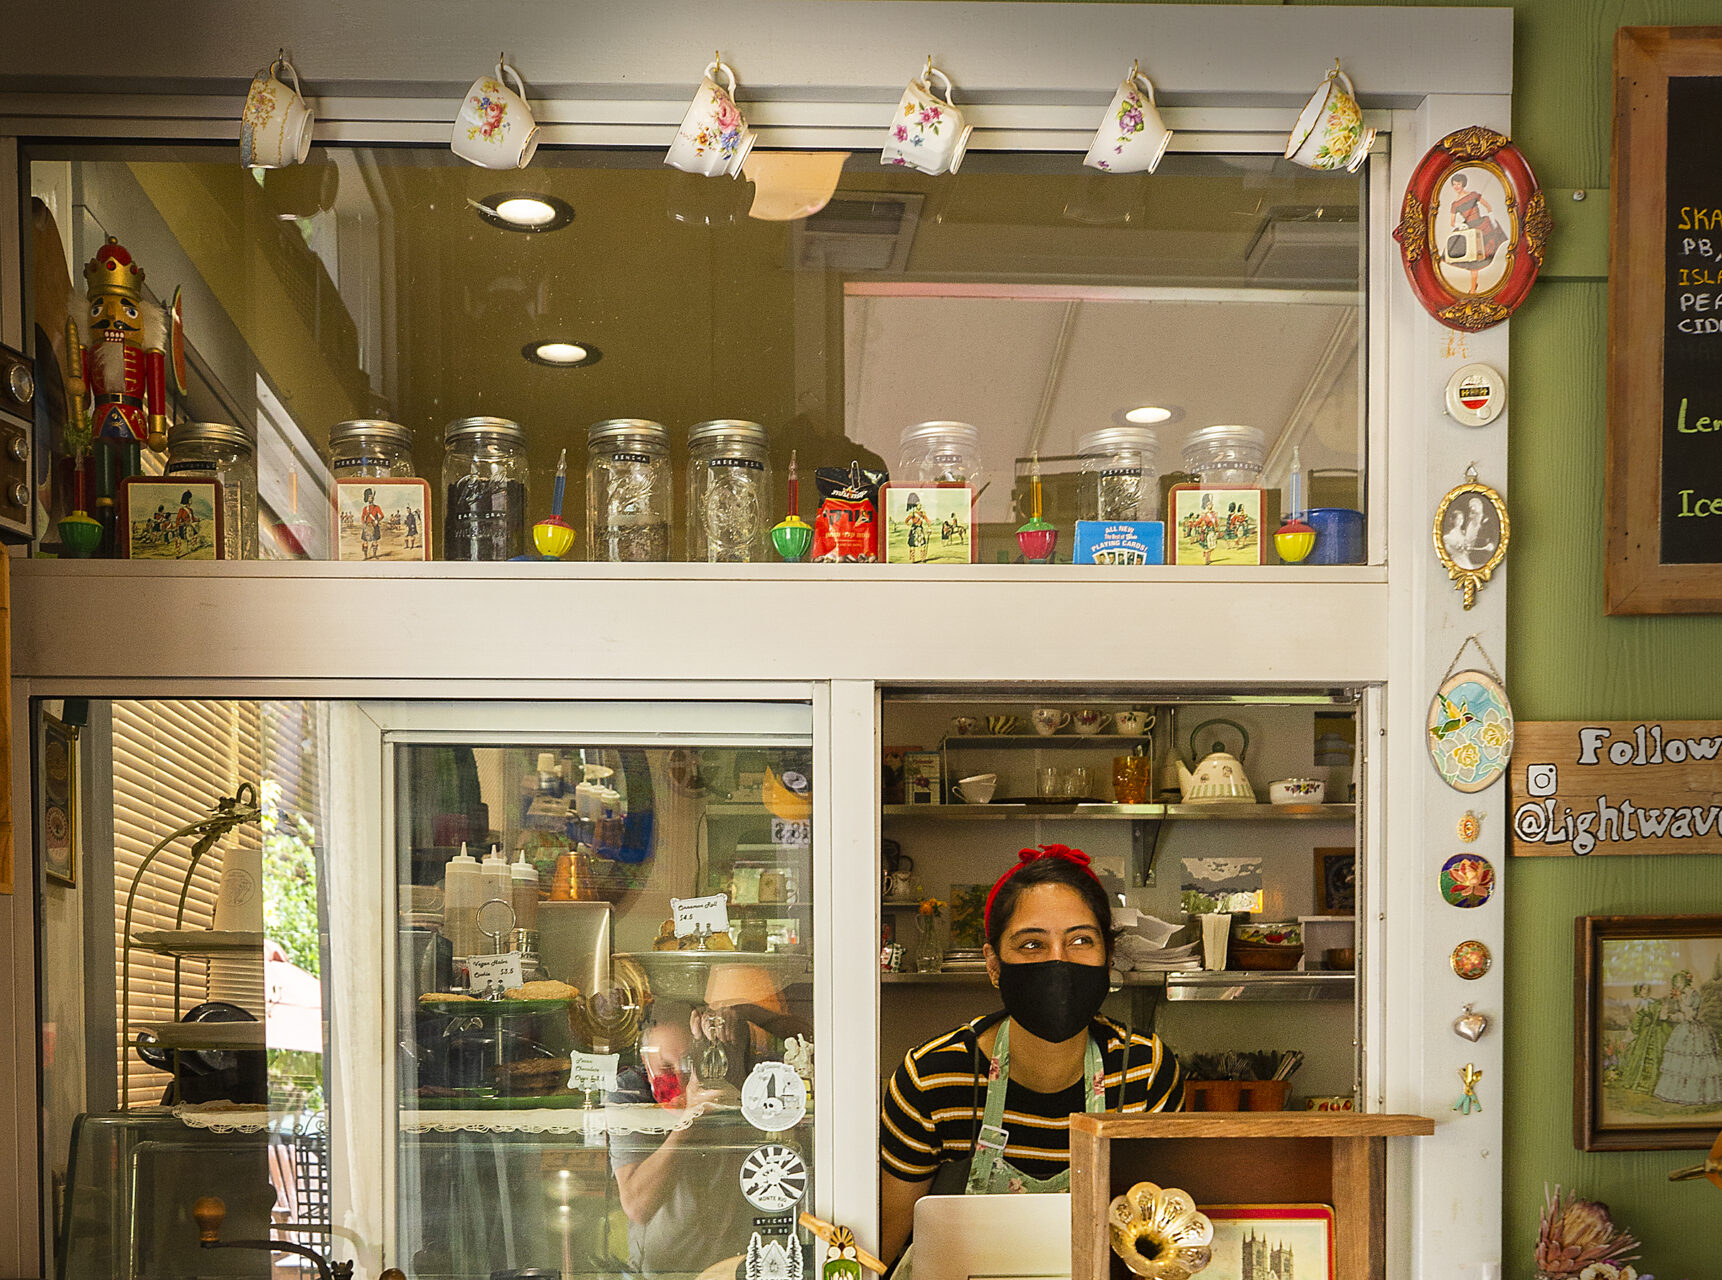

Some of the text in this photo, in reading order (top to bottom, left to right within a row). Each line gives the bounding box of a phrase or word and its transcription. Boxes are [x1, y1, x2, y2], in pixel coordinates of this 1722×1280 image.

[1682, 238, 1722, 262] PB,
[1677, 318, 1722, 334] CID
[1677, 489, 1722, 517] Ice
[458, 512, 478, 520] EARL
[1105, 525, 1135, 534] ALL NEW
[1091, 540, 1149, 552] PLAYING CARDS!
[1577, 724, 1722, 766] Follow
[1514, 795, 1722, 856] @Lightwav
[472, 960, 490, 968] Vegan
[756, 1217, 793, 1225] STICKER
